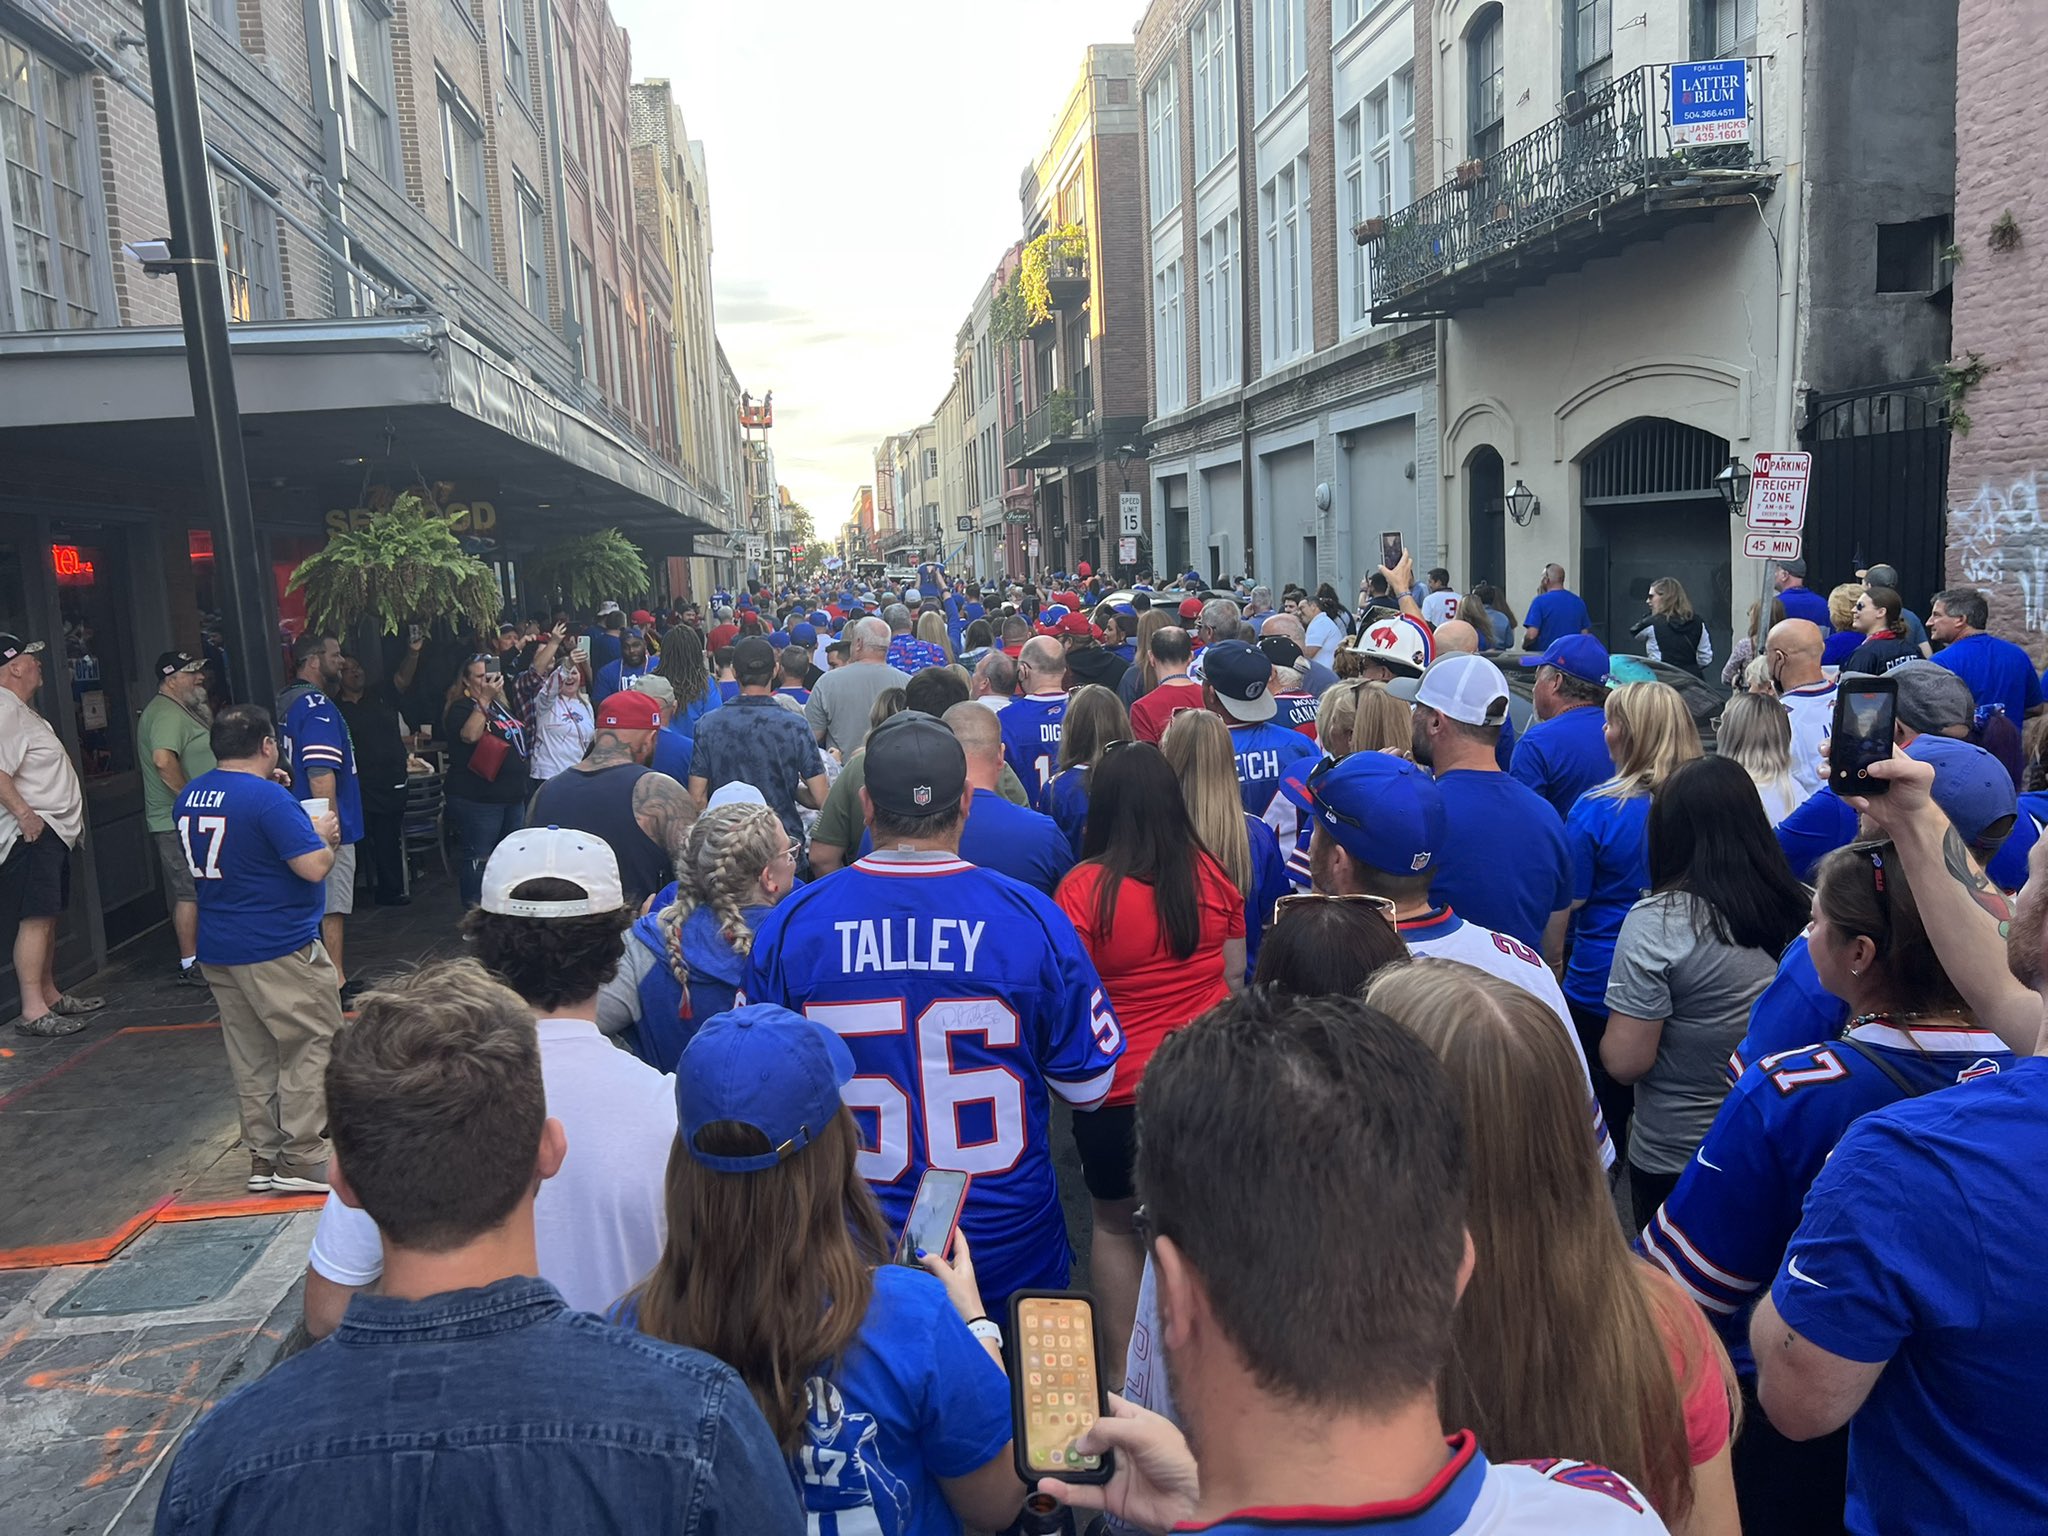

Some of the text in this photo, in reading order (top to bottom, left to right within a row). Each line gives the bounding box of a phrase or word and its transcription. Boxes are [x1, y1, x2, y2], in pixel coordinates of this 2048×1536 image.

[1681, 75, 1740, 91] LATTER
[1694, 88, 1734, 103] BLUM
[1684, 108, 1735, 120] 504.366.4511
[1690, 120, 1746, 133] JANE HICKS
[1695, 130, 1742, 142] 439-1601
[1753, 457, 1807, 473] NO PARKING
[1755, 479, 1801, 491] FREIGHT
[1121, 497, 1140, 505] SPEED
[1762, 491, 1791, 502] ZONE
[1124, 514, 1138, 530] 15
[749, 548, 761, 557] 15
[1751, 540, 1793, 552] 45 MIN
[305, 694, 326, 708] 17
[185, 790, 226, 808] ALLEN
[178, 815, 227, 878] 17
[834, 917, 986, 973] TALLEY
[1758, 1043, 1850, 1097] 17
[802, 996, 1029, 1185] 56
[801, 1444, 847, 1488] 17
